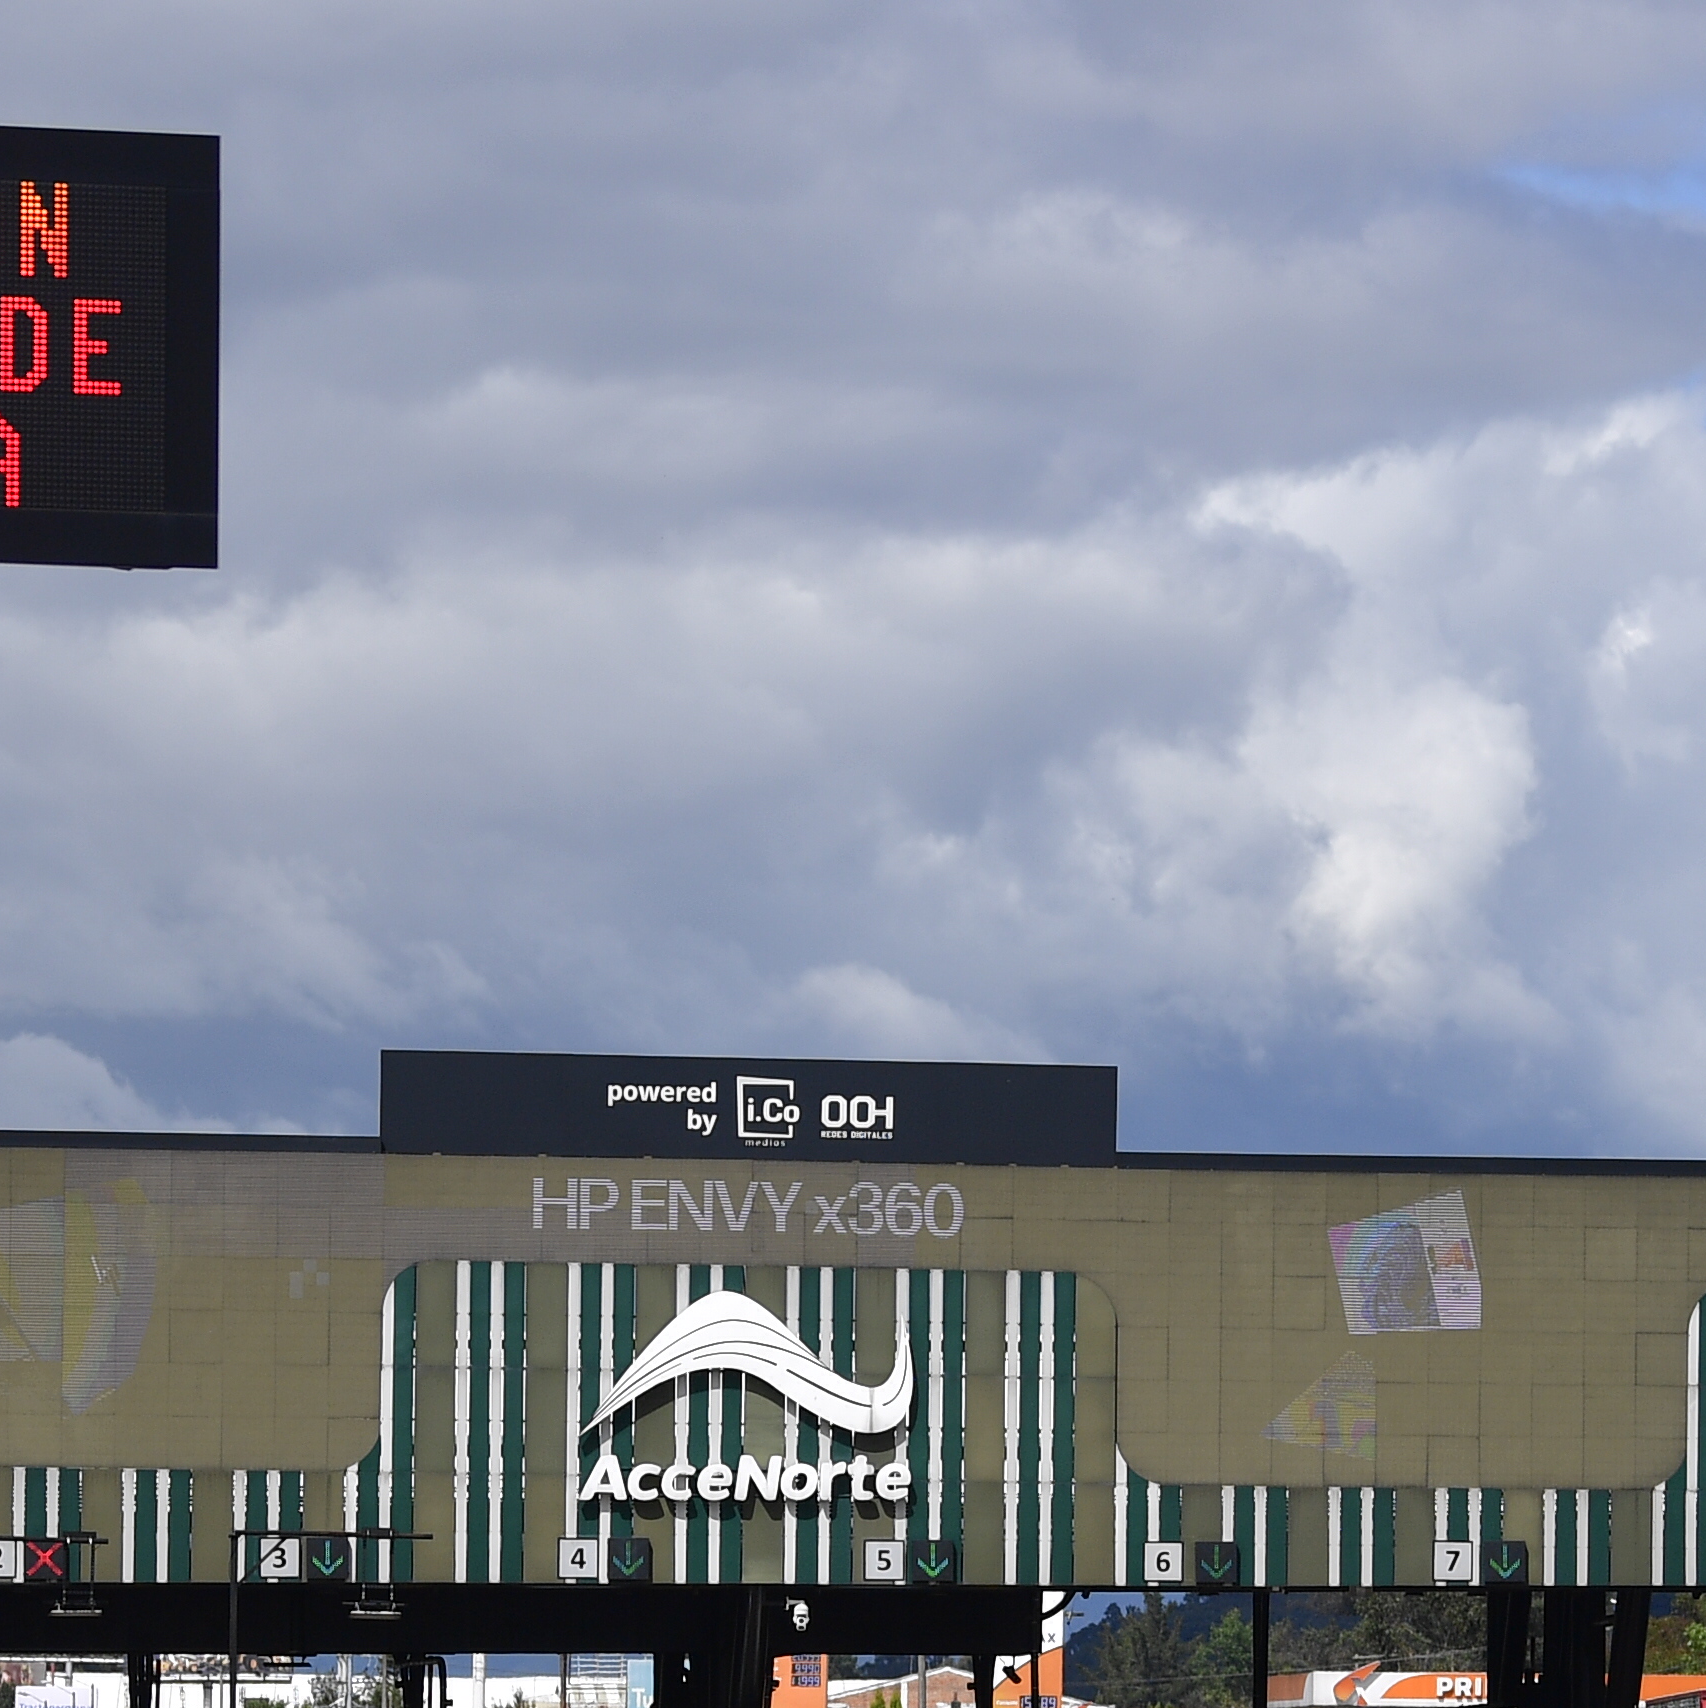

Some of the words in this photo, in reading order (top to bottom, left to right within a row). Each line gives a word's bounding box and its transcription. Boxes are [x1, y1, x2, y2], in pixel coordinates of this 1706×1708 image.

[0, 295, 123, 397] DE
[607, 1082, 717, 1106] powered
[687, 1109, 717, 1135] by
[745, 1138, 786, 1147] medios
[851, 1131, 893, 1139] DIGITALES
[532, 1179, 618, 1230] HP
[631, 1180, 802, 1233] ENVY
[812, 1182, 965, 1239] x360
[581, 1453, 912, 1503] AcceNorte
[271, 1547, 288, 1571] 3
[569, 1548, 589, 1571] 4
[877, 1550, 893, 1573] 5
[1155, 1551, 1171, 1573] 6
[1445, 1550, 1461, 1574] 7
[1437, 1677, 1486, 1697] PRI
